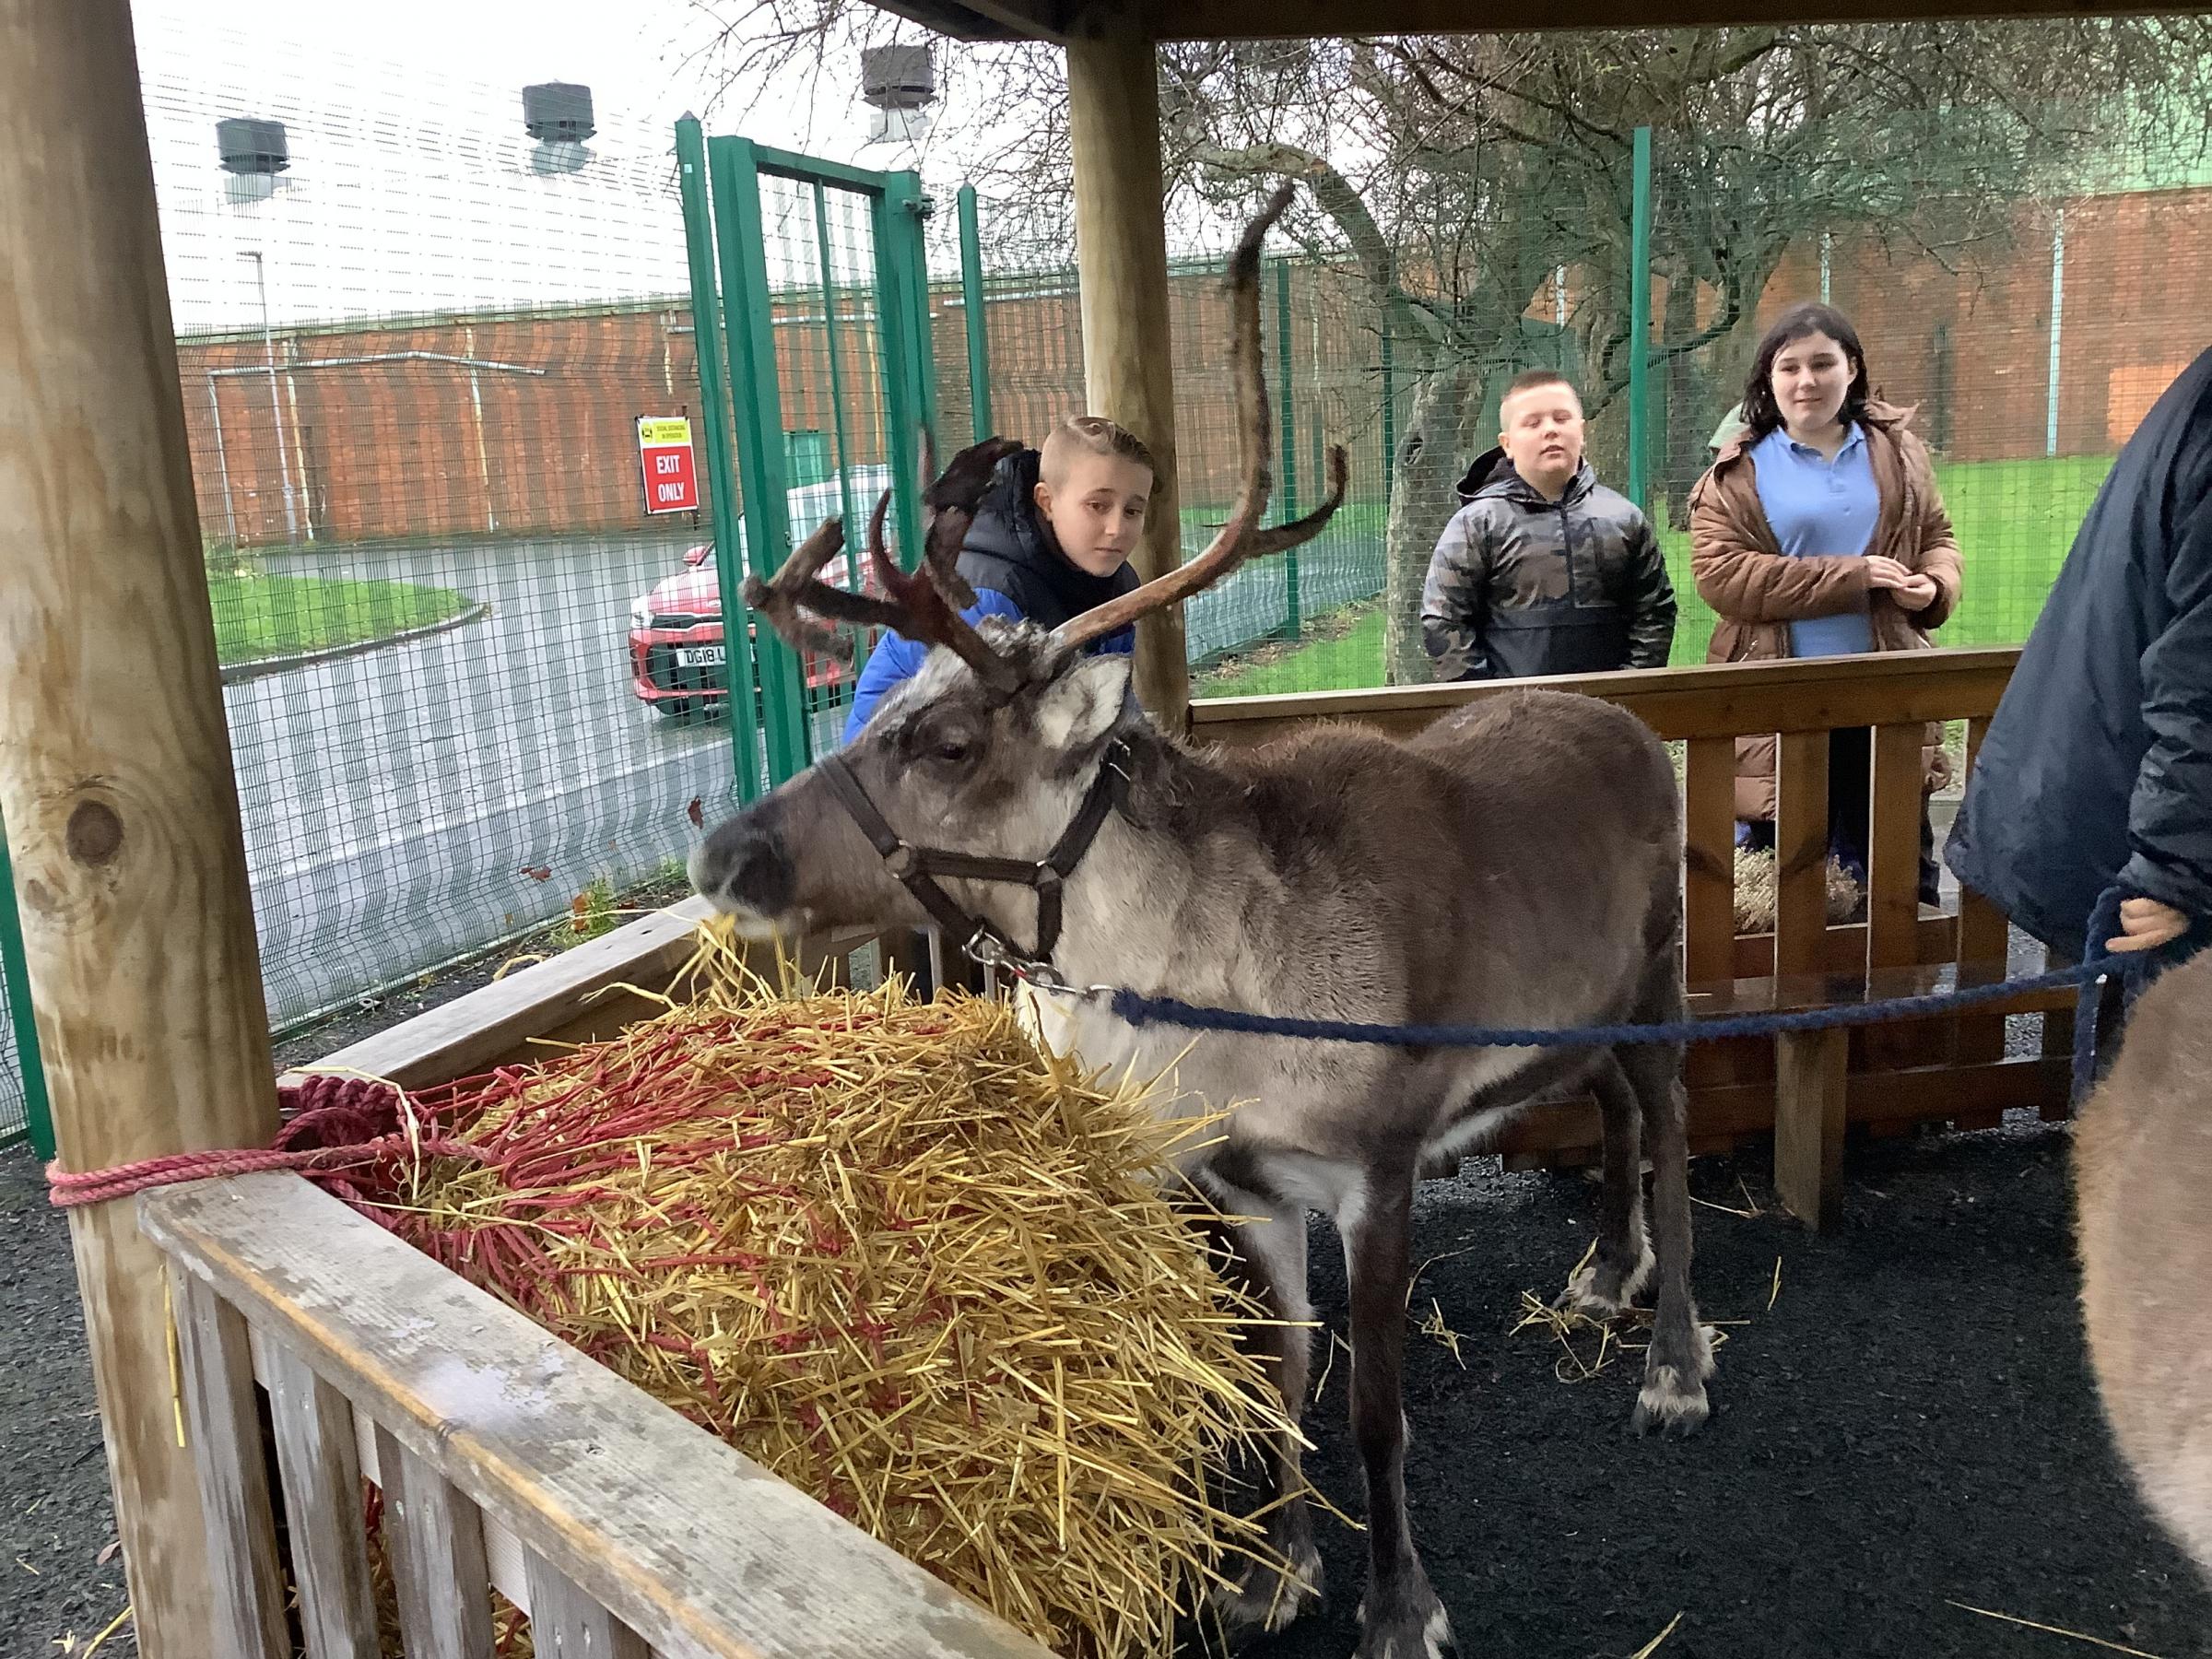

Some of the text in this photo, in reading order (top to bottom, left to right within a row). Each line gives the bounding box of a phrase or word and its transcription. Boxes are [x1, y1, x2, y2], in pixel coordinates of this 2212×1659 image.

[656, 454, 680, 474] EXIT
[657, 482, 685, 502] ONLY
[685, 649, 715, 664] DG18
